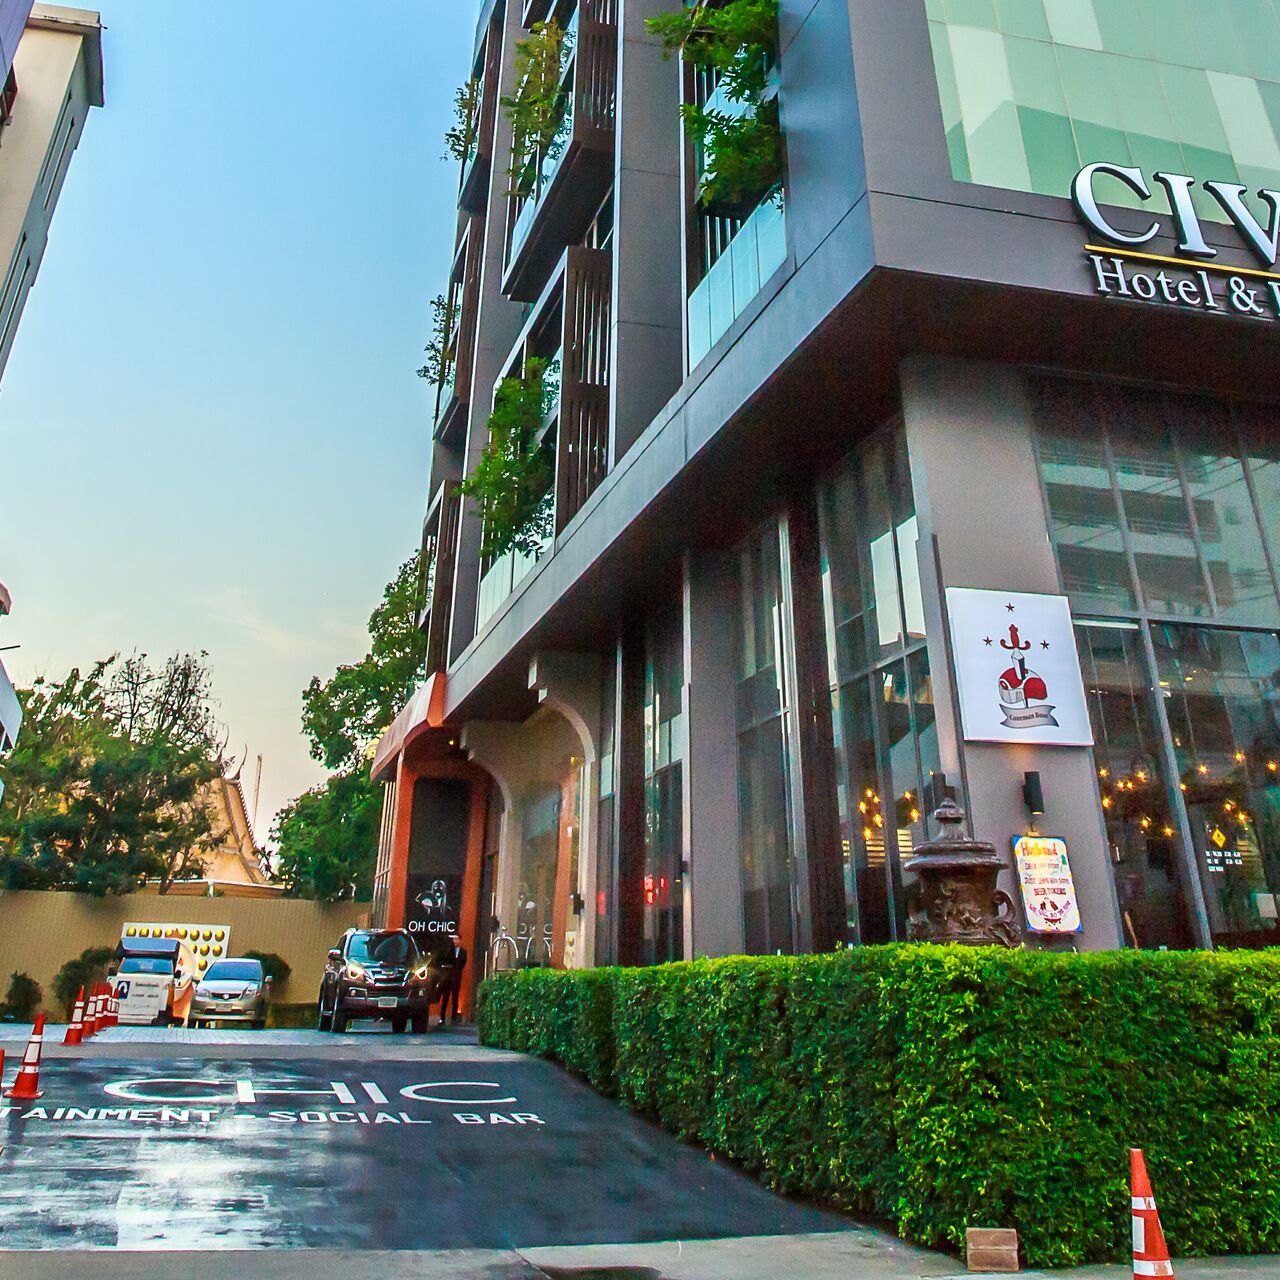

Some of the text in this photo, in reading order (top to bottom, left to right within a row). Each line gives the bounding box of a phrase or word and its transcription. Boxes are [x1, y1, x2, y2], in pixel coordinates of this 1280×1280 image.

[1089, 254, 1220, 310] Hotel
[1226, 275, 1265, 316] &
[408, 920, 456, 933] OH CHIC
[103, 1078, 518, 1105] CHIC
[268, 1111, 432, 1125] SOCIAL
[452, 1112, 546, 1126] BAR
